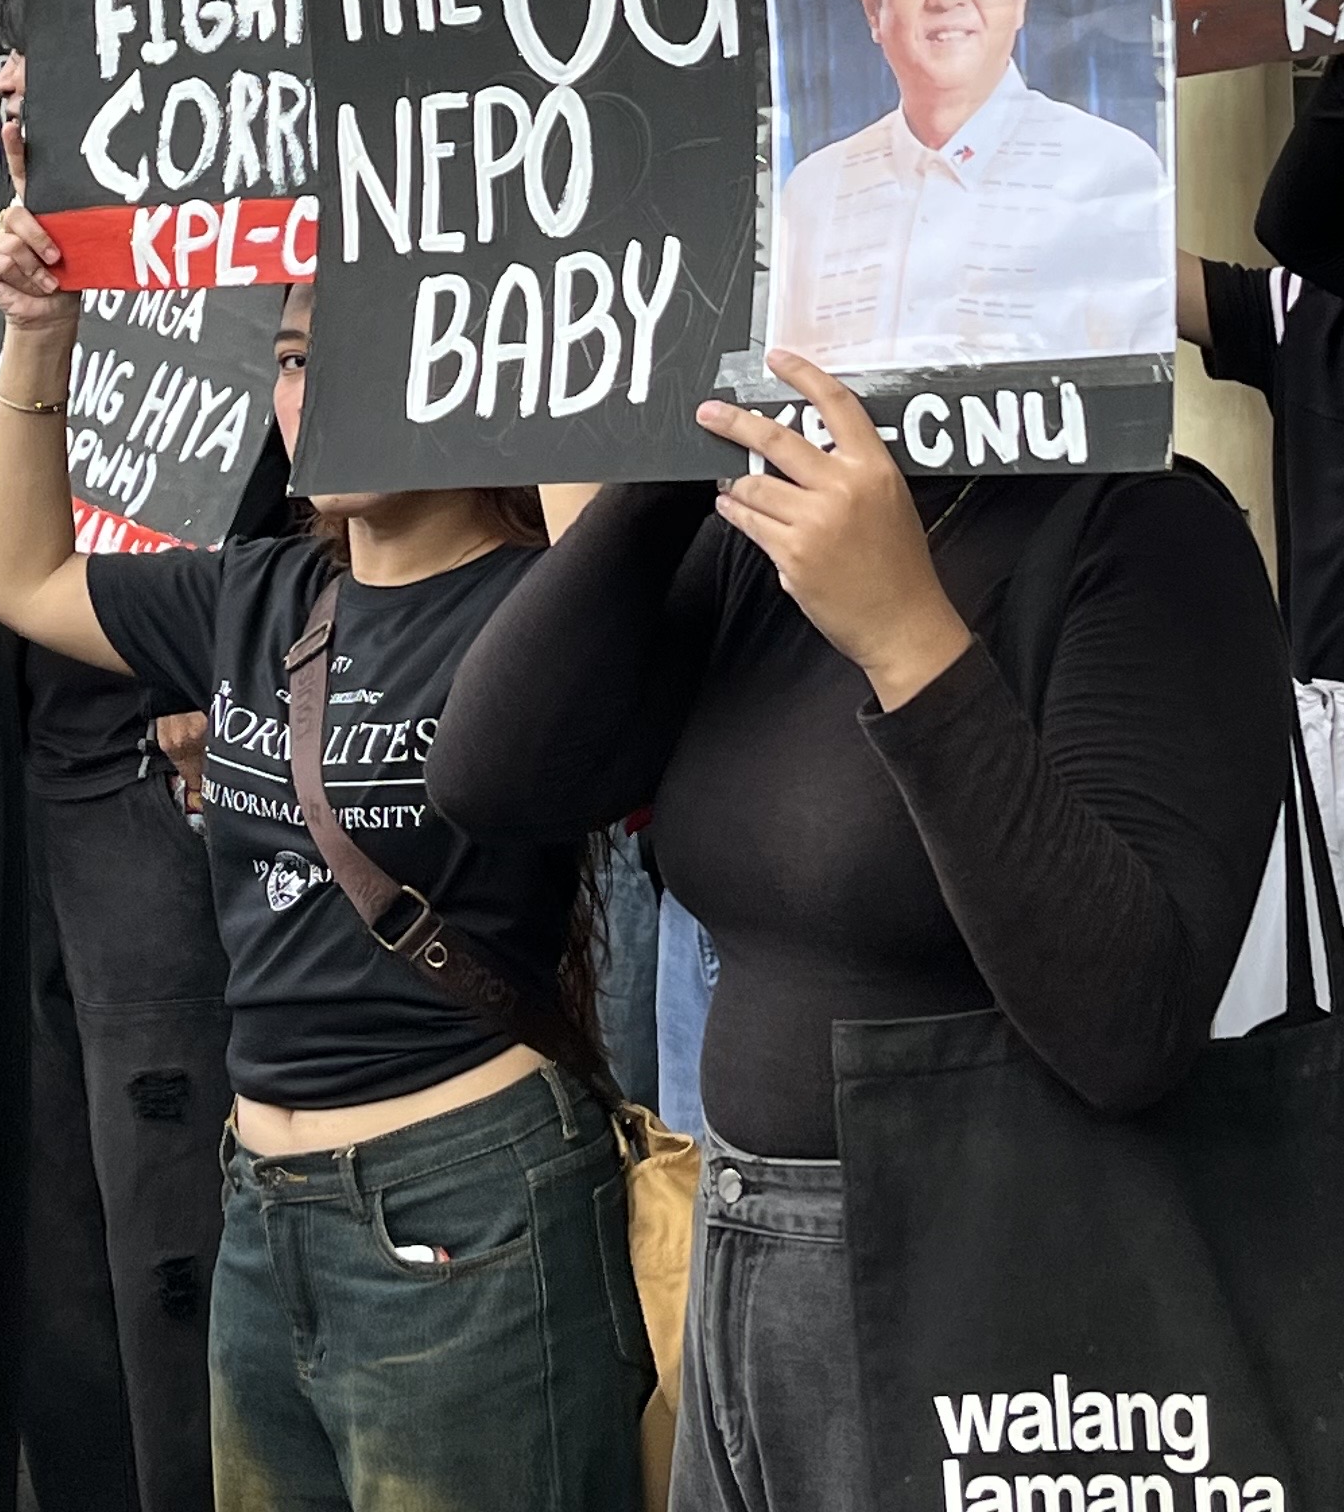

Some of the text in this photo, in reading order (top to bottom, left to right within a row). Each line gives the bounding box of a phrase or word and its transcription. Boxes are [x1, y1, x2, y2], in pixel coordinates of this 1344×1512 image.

[80, 68, 318, 203] CORR
[336, 85, 595, 264] NEPO
[129, 195, 319, 289] KPL-C
[406, 235, 682, 425] BABY
[126, 360, 251, 473] HIYA
[933, 1373, 1212, 1474] walang
